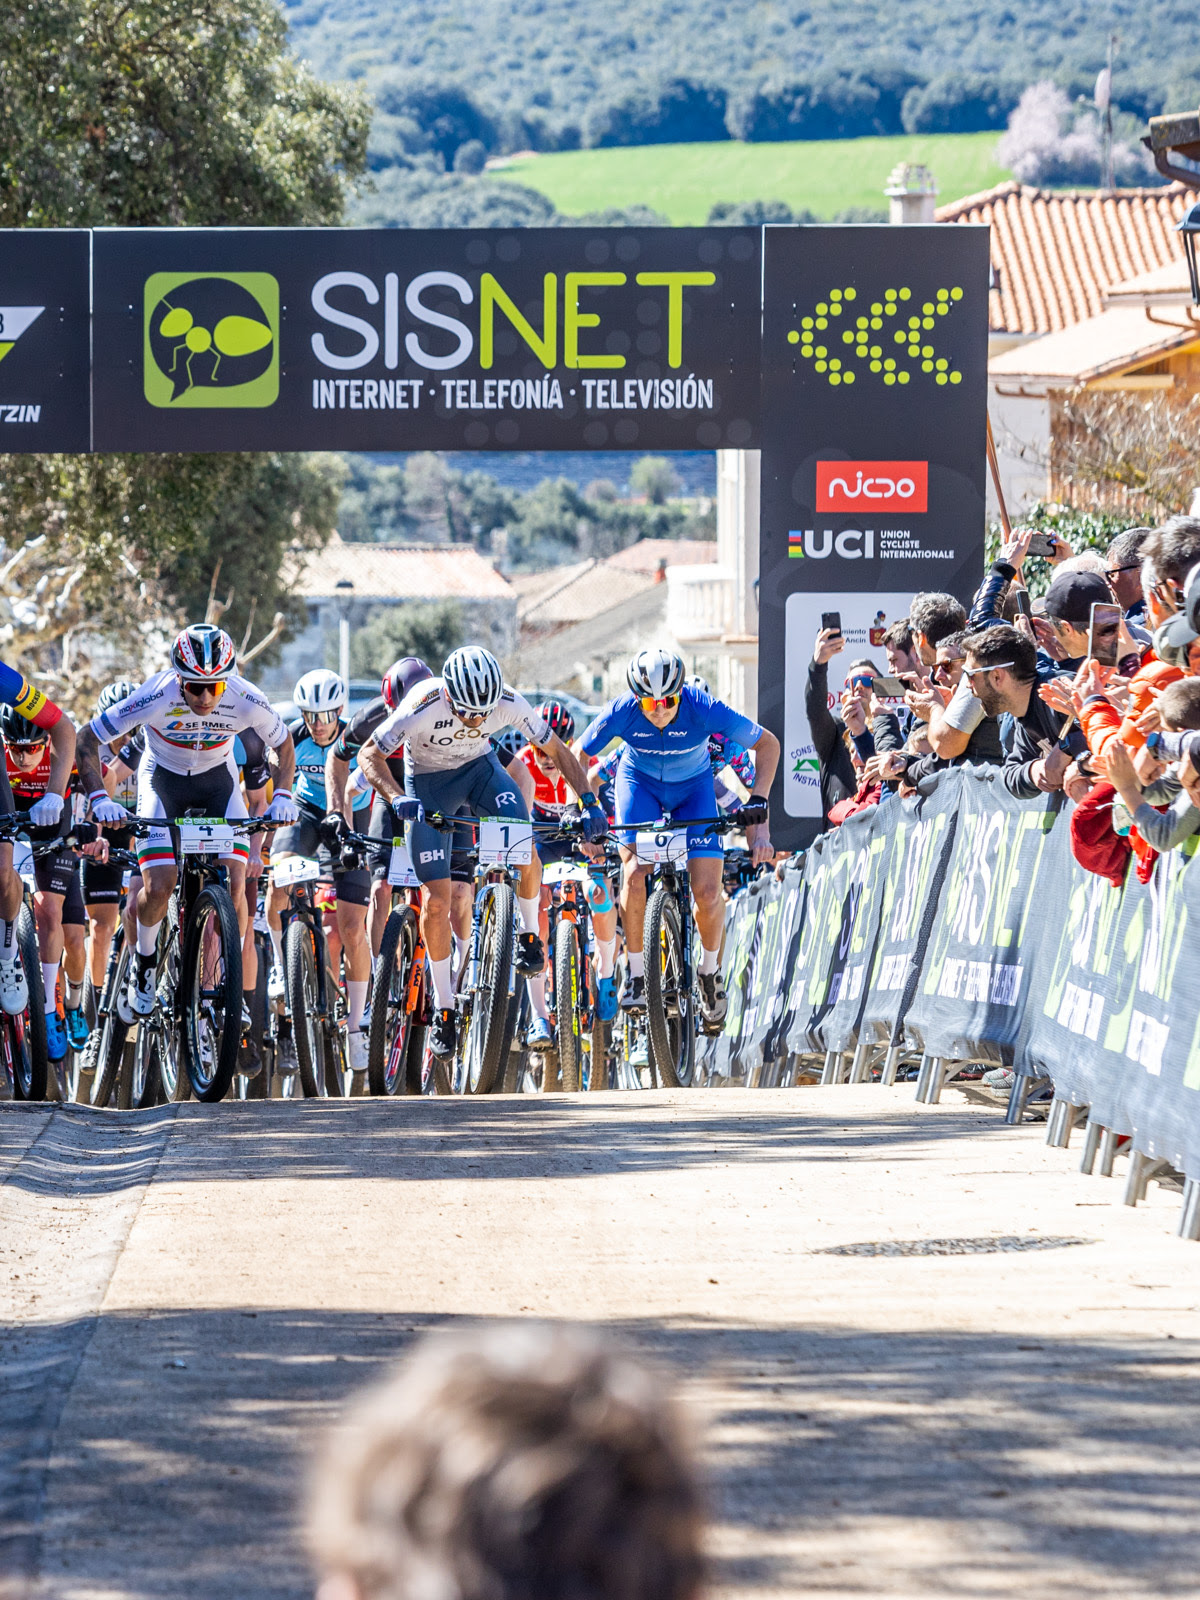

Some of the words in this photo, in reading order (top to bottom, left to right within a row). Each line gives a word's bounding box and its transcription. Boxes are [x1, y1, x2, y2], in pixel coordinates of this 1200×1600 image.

[311, 271, 716, 371] SISNET
[312, 379, 424, 409] INTERNET
[441, 373, 564, 409] TELEFONÍA
[582, 373, 714, 409] TELEVISIÓN
[803, 529, 874, 559] UCI
[880, 530, 910, 539] UNION
[880, 539, 920, 549] CYCLISTE
[880, 549, 955, 559] INTERNATIONALE
[433, 718, 454, 730] BH
[499, 825, 510, 849] 1
[654, 832, 669, 848] 6
[419, 849, 446, 865] BH
